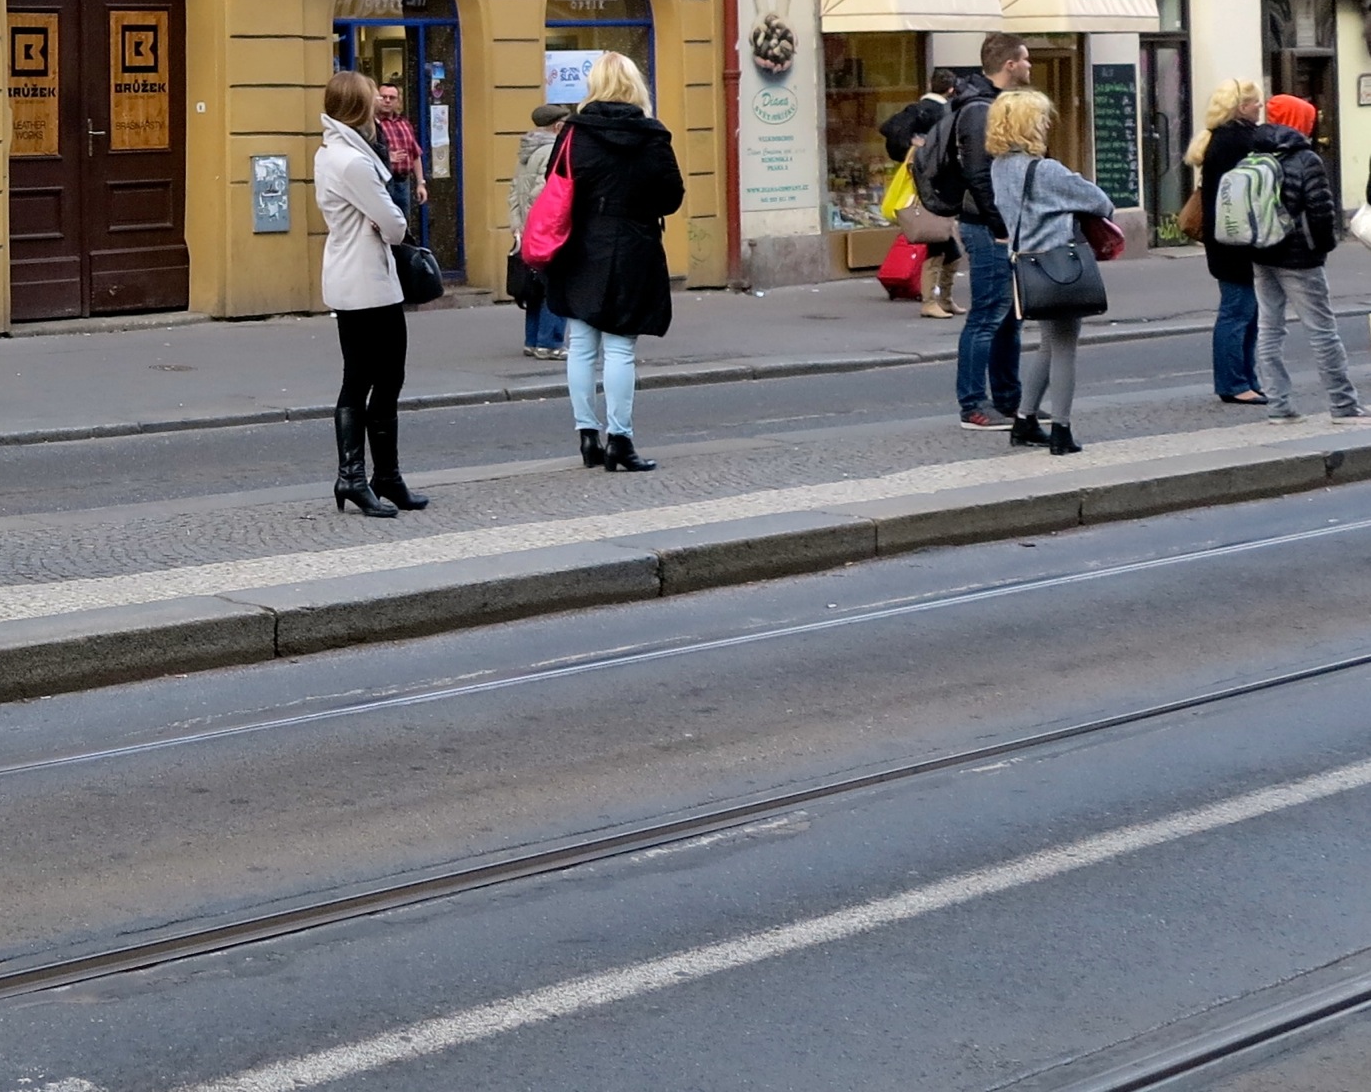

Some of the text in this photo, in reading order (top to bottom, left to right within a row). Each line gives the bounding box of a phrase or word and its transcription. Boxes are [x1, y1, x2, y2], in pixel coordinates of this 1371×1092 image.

[571, 1, 606, 10] OPTIK
[114, 79, 166, 94] BRŮŽEK
[13, 120, 46, 130] LEATHER
[15, 130, 44, 140] WORKS
